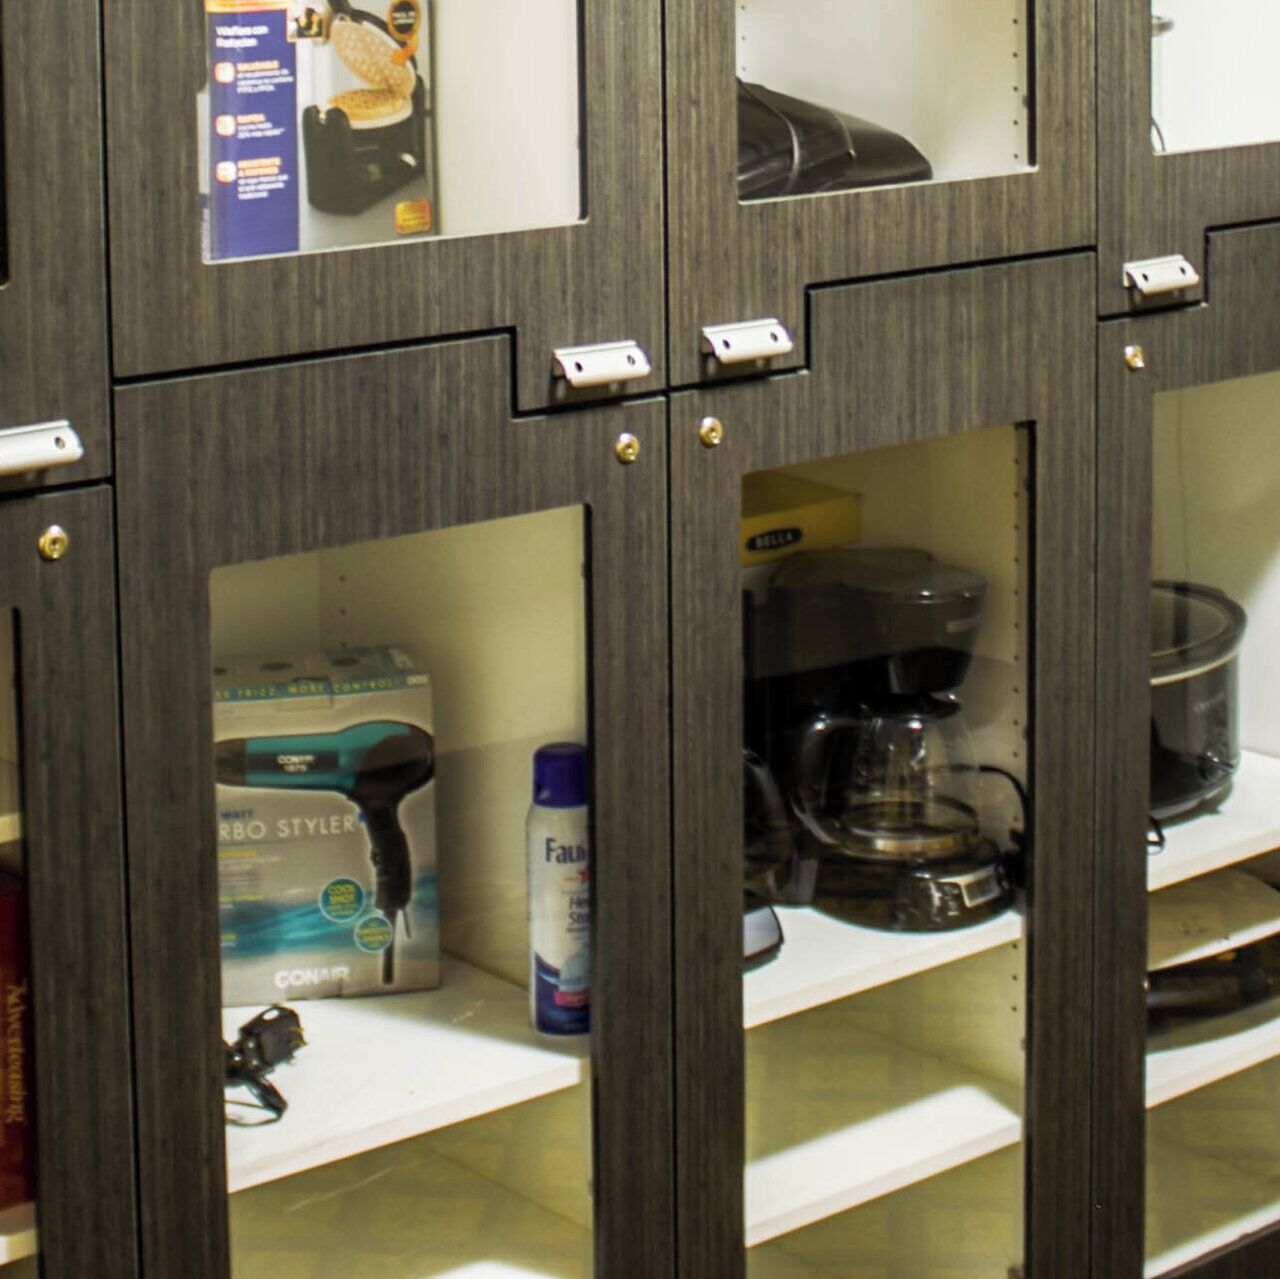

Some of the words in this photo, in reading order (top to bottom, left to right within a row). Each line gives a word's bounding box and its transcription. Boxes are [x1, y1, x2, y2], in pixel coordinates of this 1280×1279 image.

[219, 820, 268, 841] RBO
[277, 814, 356, 839] STYLER
[274, 964, 351, 989] CONAIR
